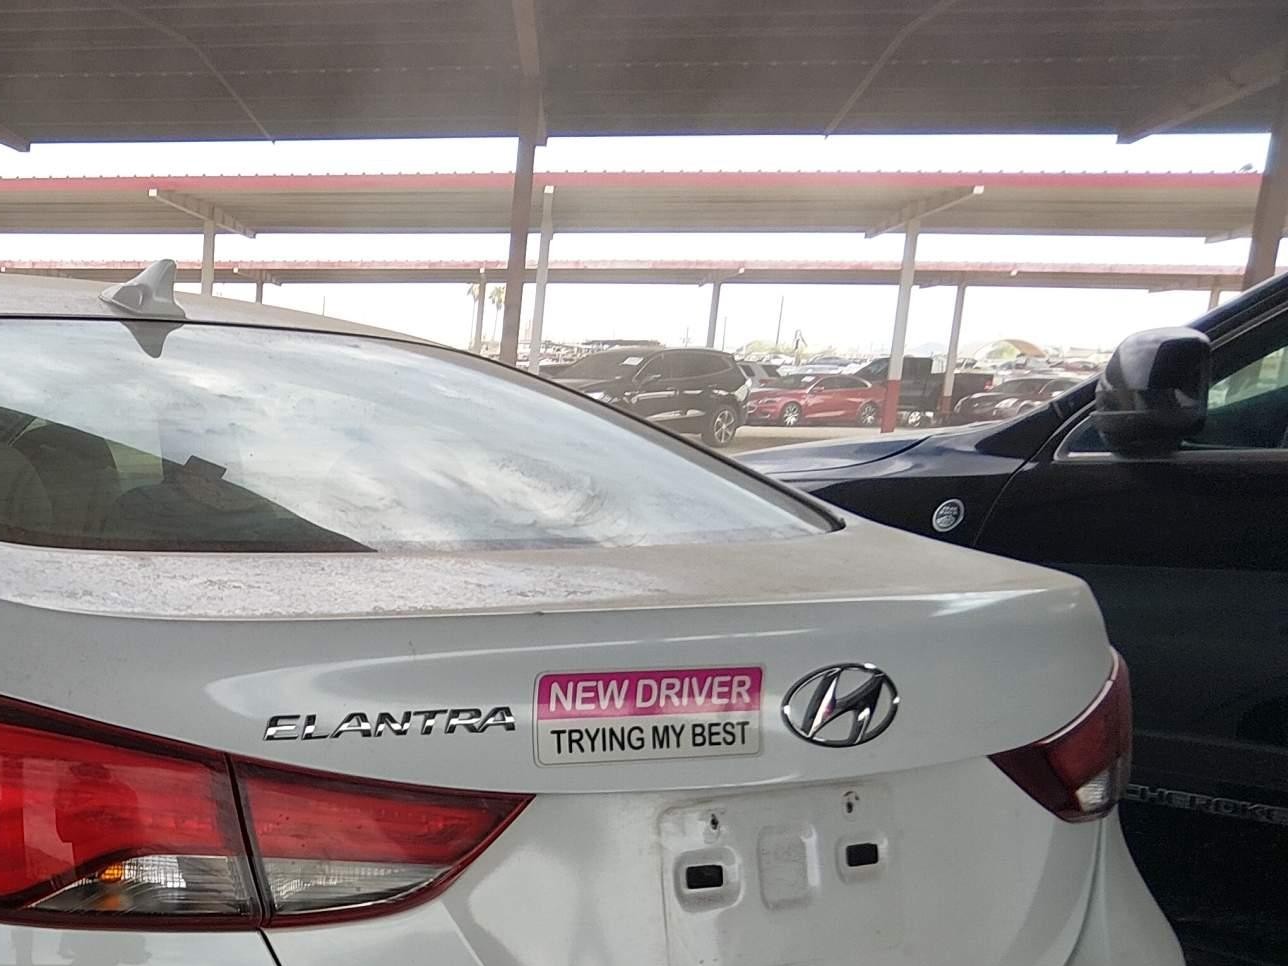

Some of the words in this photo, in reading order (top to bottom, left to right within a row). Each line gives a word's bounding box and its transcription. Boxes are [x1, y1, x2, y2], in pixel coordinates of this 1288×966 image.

[549, 680, 629, 712] NEW
[635, 675, 752, 708] DRIVER
[262, 706, 516, 741] ELANTRA
[550, 726, 645, 755] TRYING
[651, 723, 686, 750] MY
[691, 721, 750, 748] BEST
